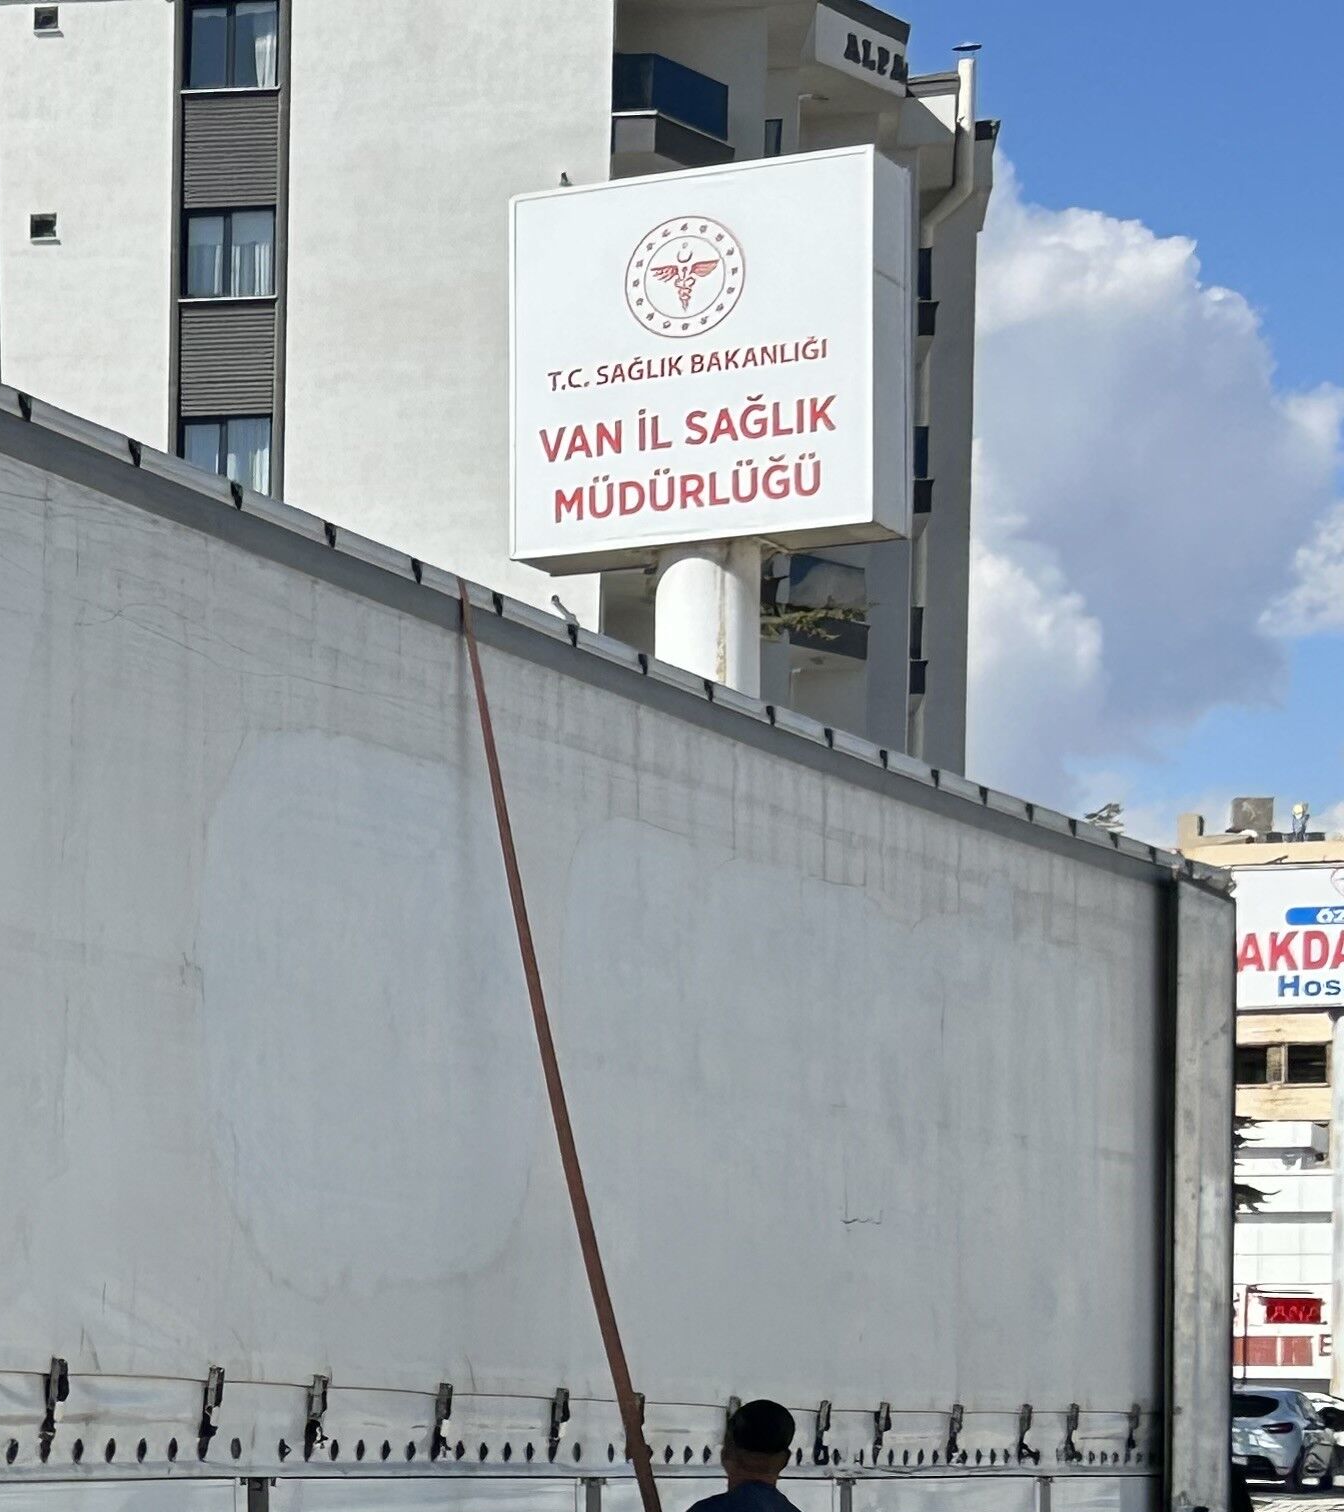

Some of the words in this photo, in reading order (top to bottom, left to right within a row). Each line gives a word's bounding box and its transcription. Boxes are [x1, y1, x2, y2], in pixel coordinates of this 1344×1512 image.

[548, 368, 591, 392] T.C.
[596, 355, 683, 386] SAĞLIK
[690, 336, 828, 374] BAKANLIĞI
[539, 420, 622, 463] VAN
[637, 408, 672, 452] İL
[685, 394, 837, 446] SAĞLIK
[553, 452, 822, 523] MÜDÜRLÜĞÜ
